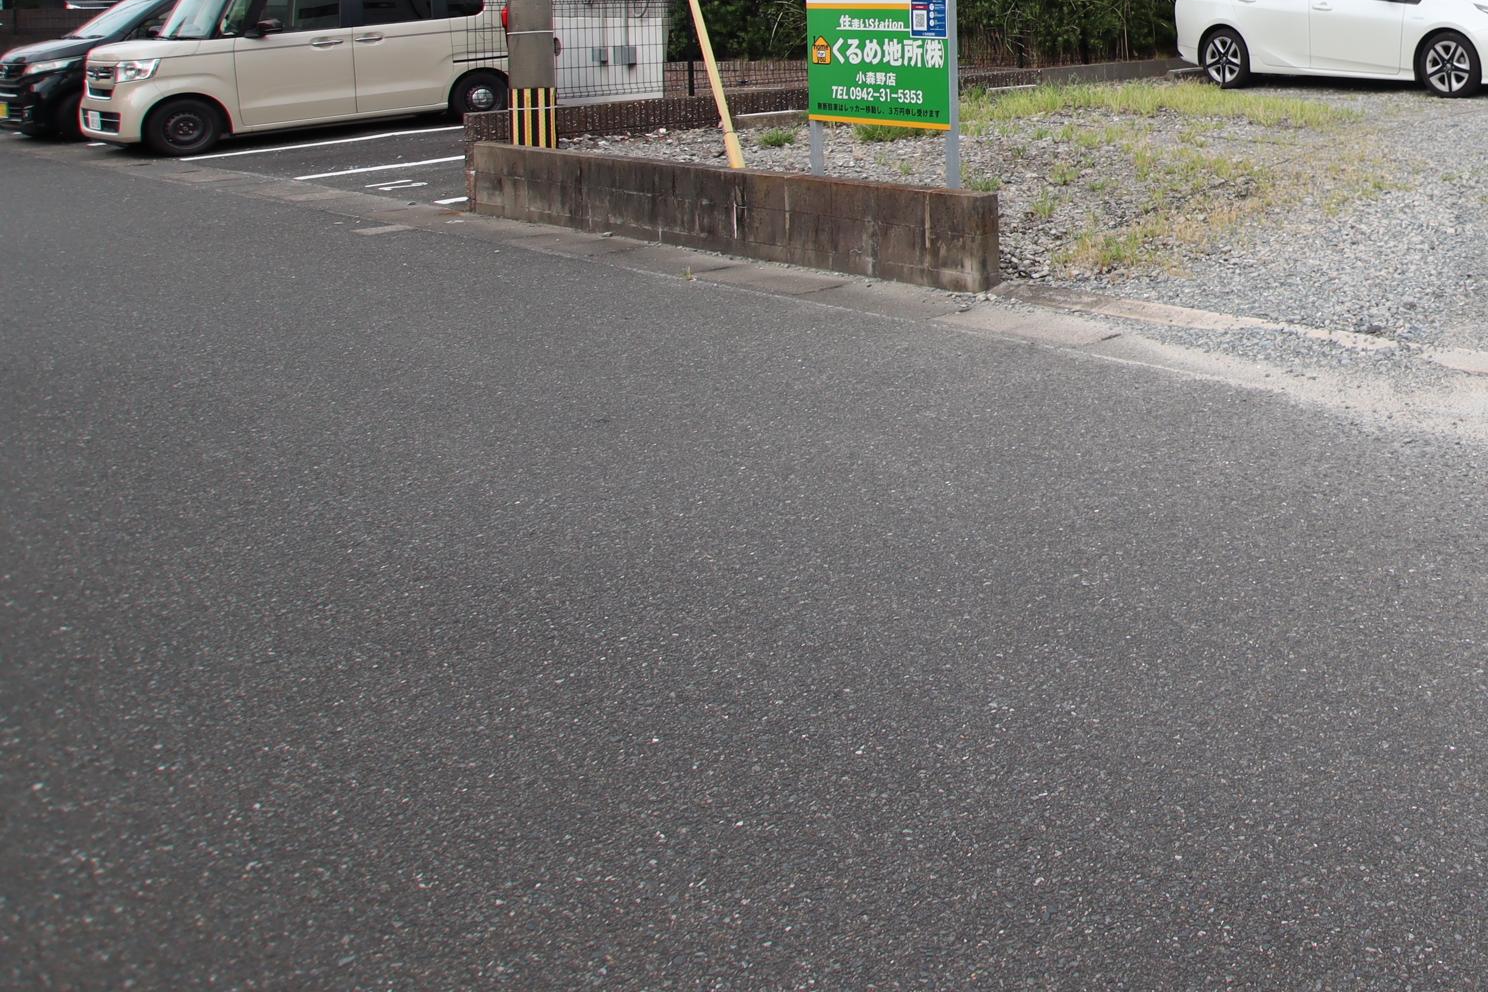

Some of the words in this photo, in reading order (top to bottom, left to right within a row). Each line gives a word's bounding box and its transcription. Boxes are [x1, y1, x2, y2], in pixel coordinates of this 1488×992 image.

[856, 71, 897, 86] 小森野店
[832, 86, 848, 99] TEL
[850, 87, 923, 104] 0942-31-5353
